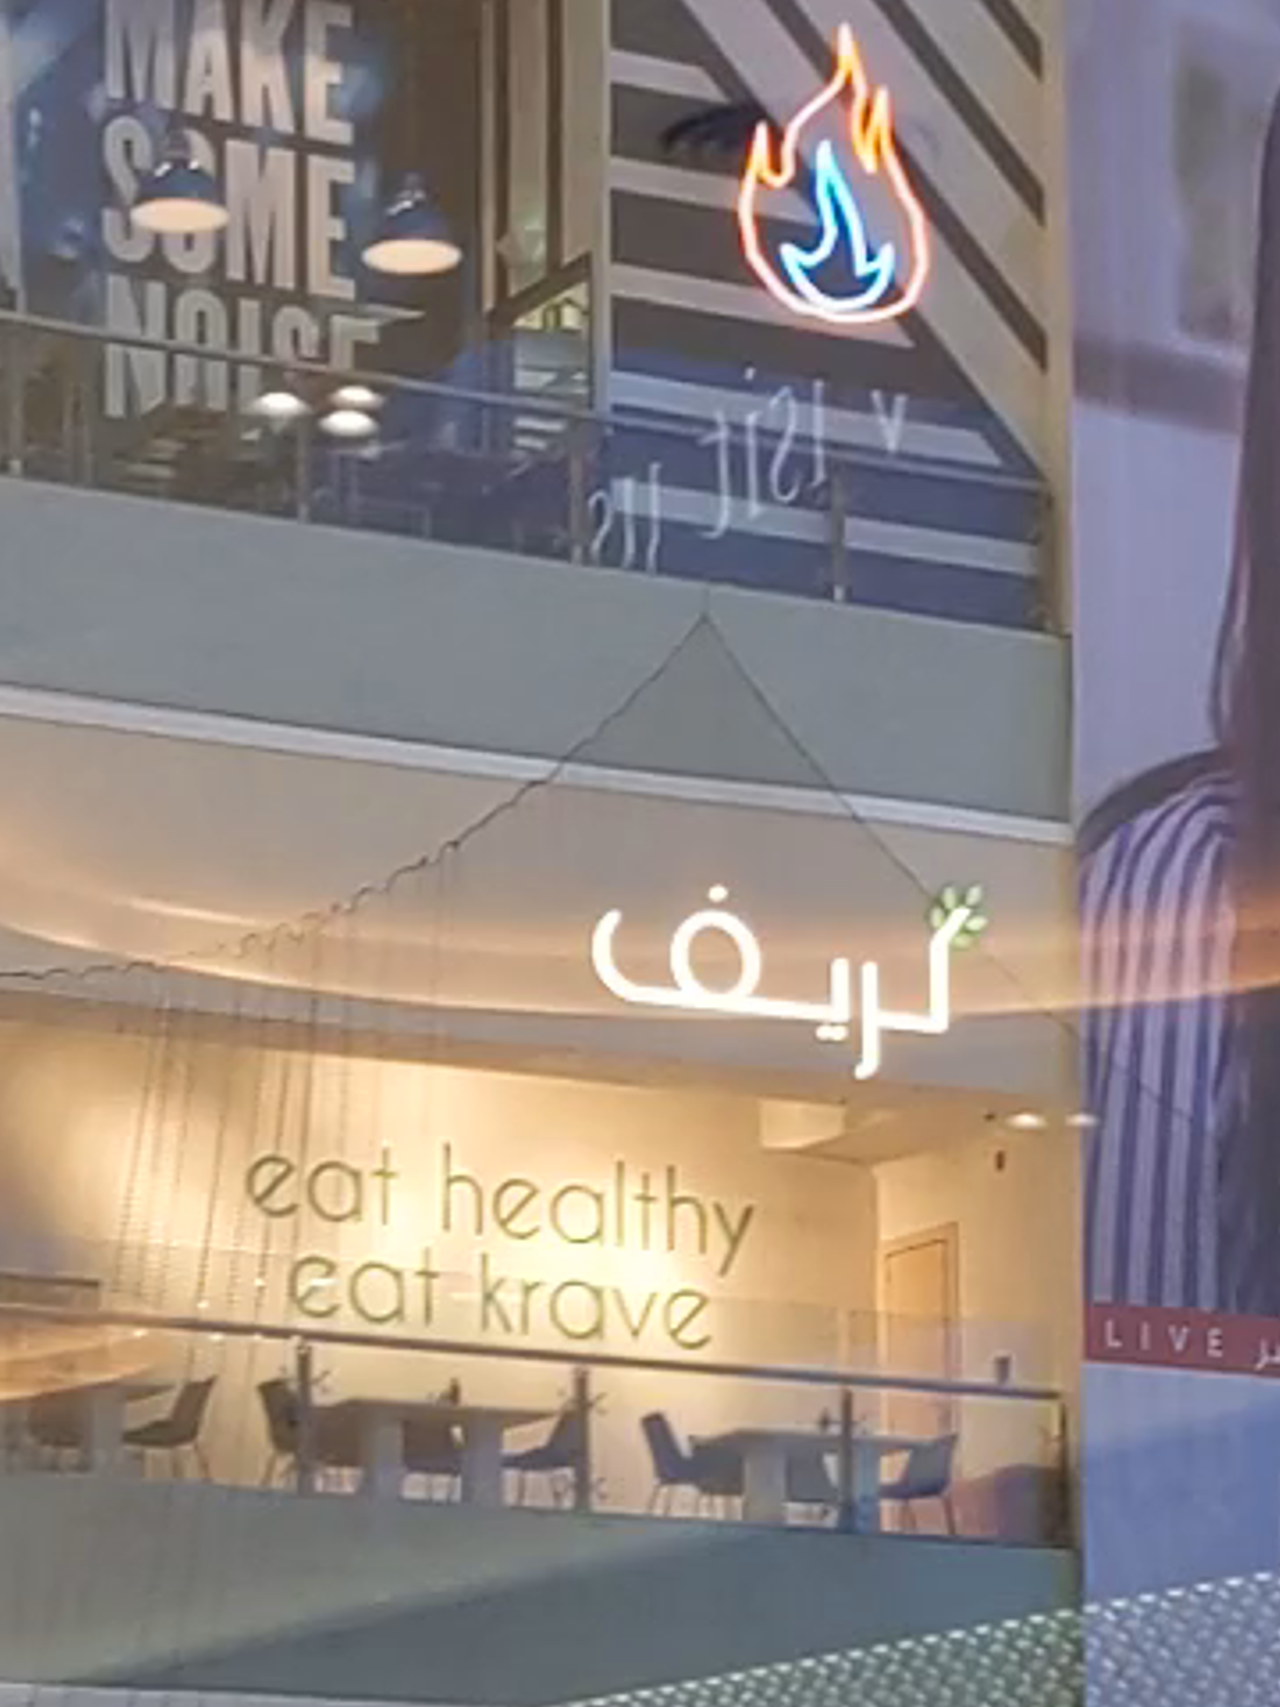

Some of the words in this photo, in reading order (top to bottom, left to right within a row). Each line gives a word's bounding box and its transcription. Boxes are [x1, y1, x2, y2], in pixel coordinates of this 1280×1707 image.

[101, 115, 357, 301] SOME
[245, 1143, 398, 1227] eat
[441, 1142, 754, 1275] healthy
[288, 1247, 440, 1319] eat
[480, 1253, 714, 1350] krave
[1105, 1319, 1223, 1358] LIVE
